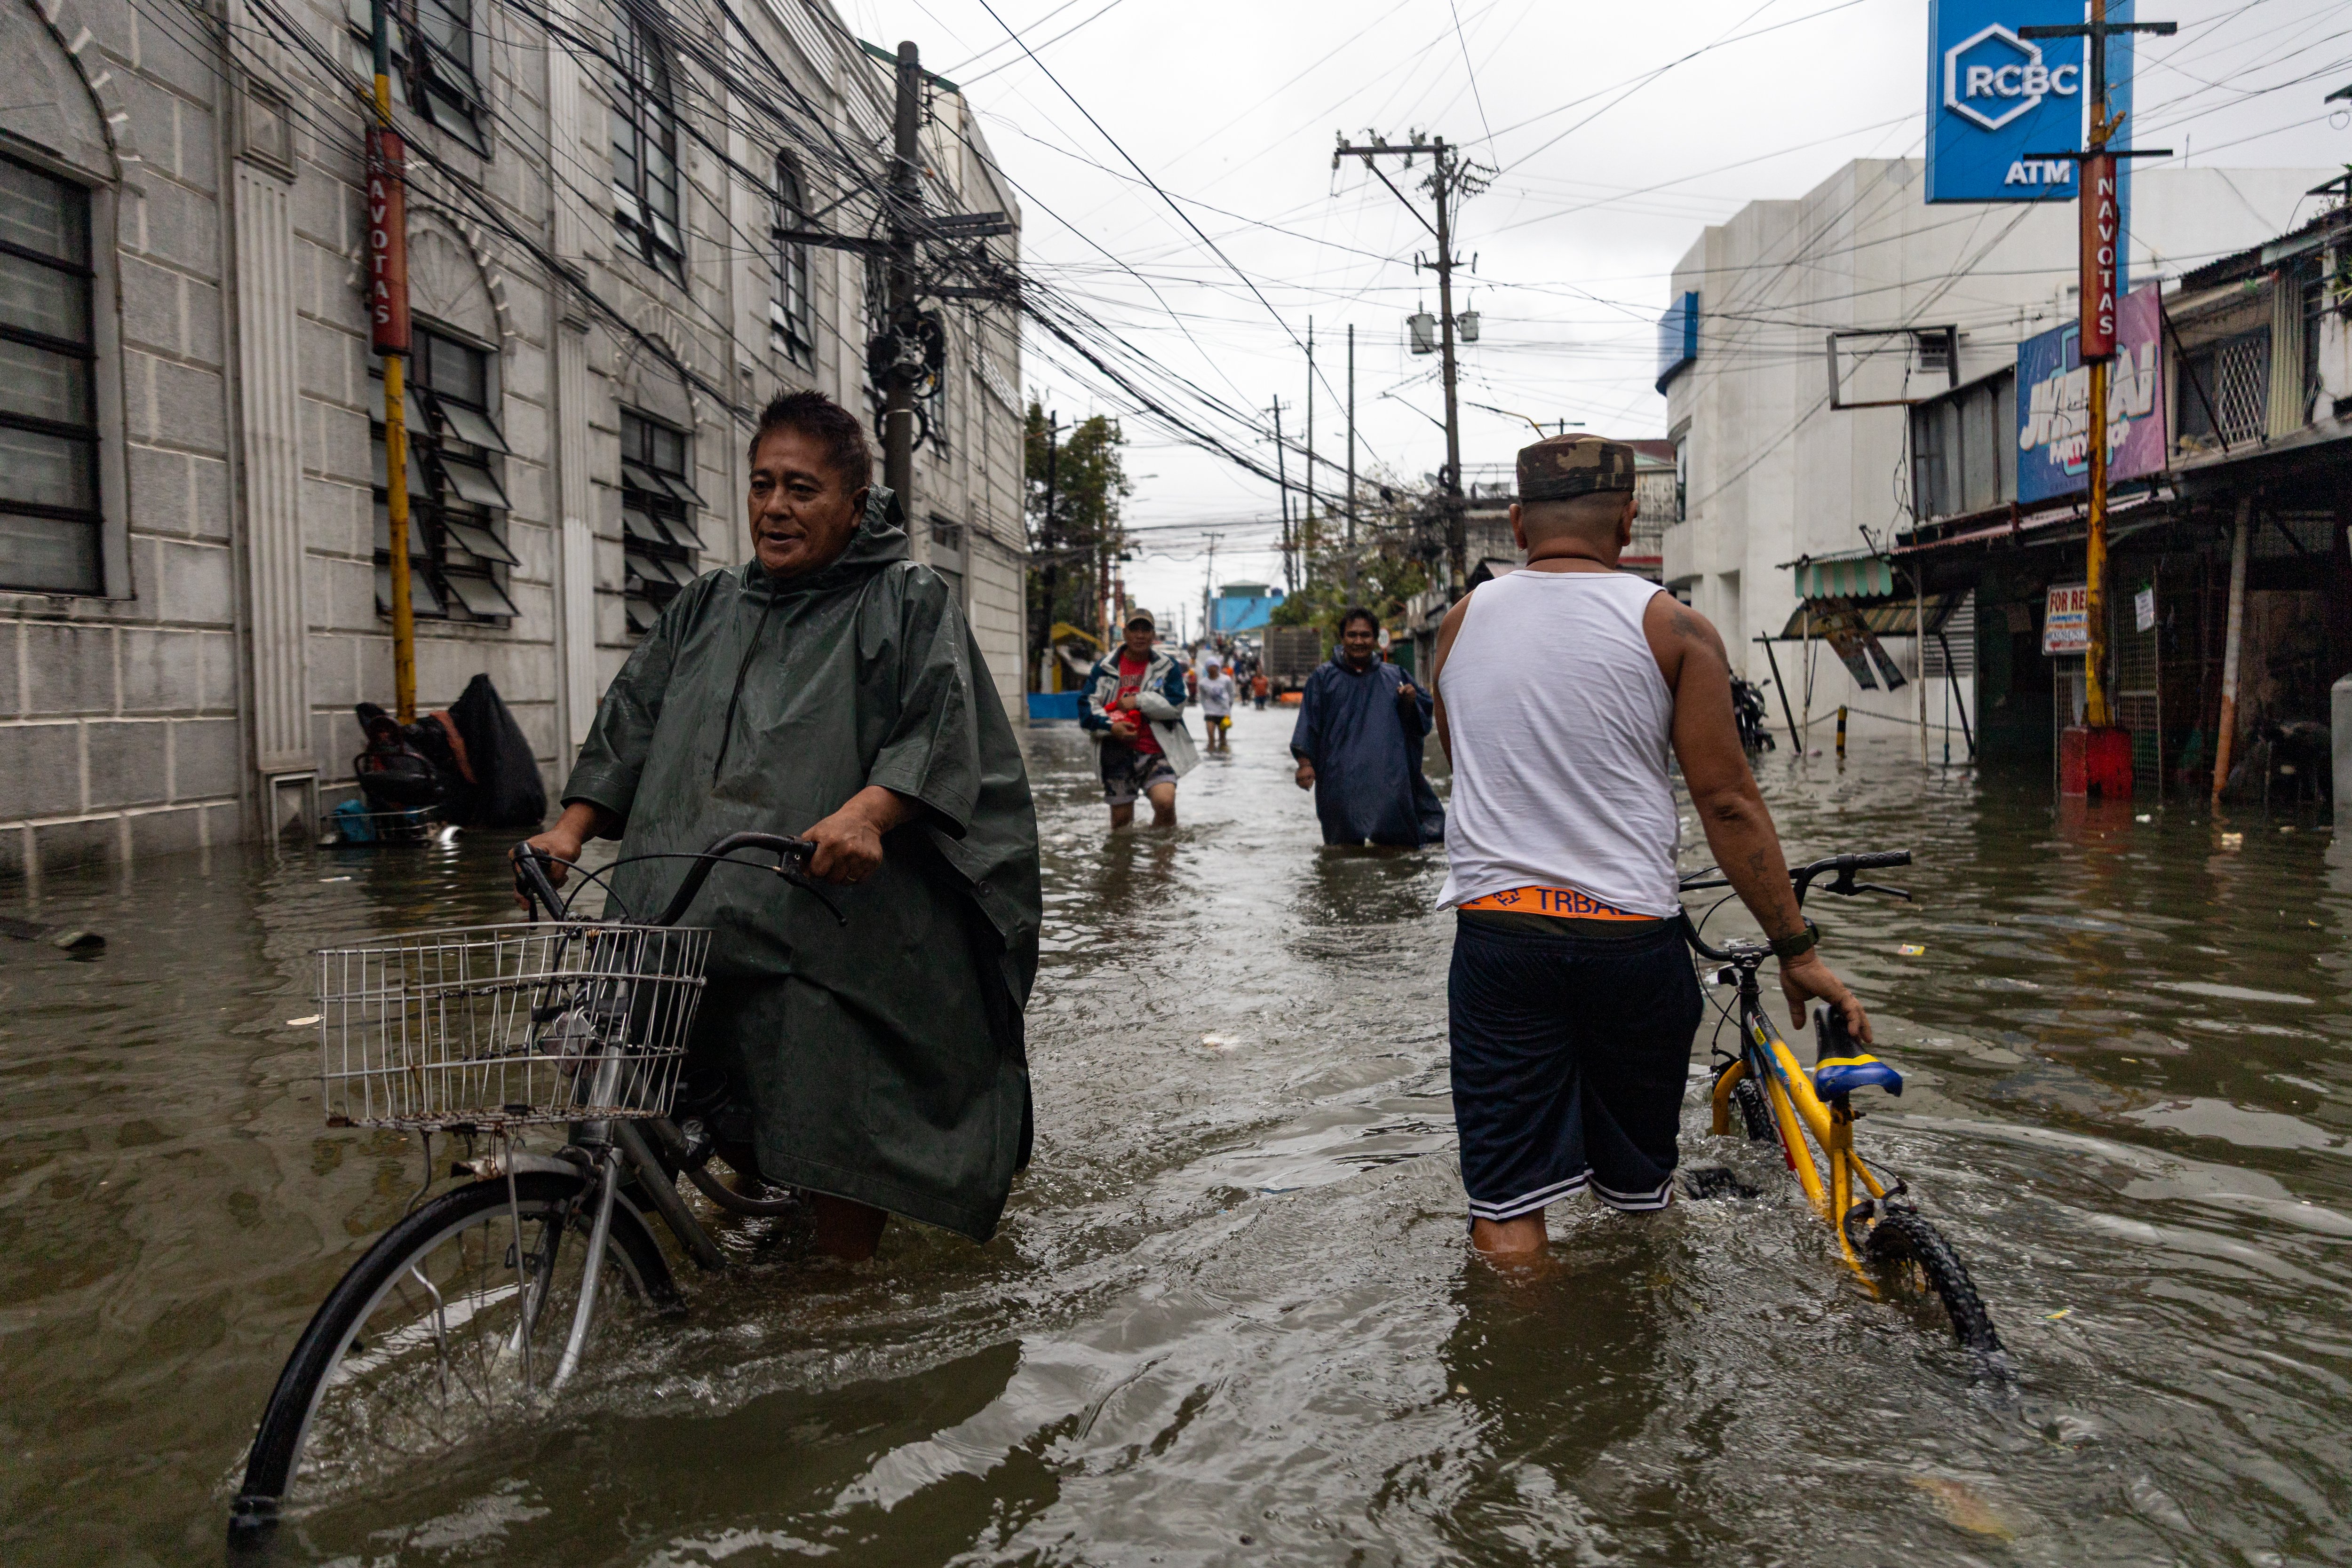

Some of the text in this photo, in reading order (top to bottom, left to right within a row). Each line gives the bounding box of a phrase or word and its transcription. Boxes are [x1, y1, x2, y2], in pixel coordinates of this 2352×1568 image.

[1966, 64, 2079, 97] RCBC
[2004, 160, 2070, 184] ATM
[2097, 177, 2114, 335] NAVOTAS
[2050, 589, 2088, 612] FOR RE
